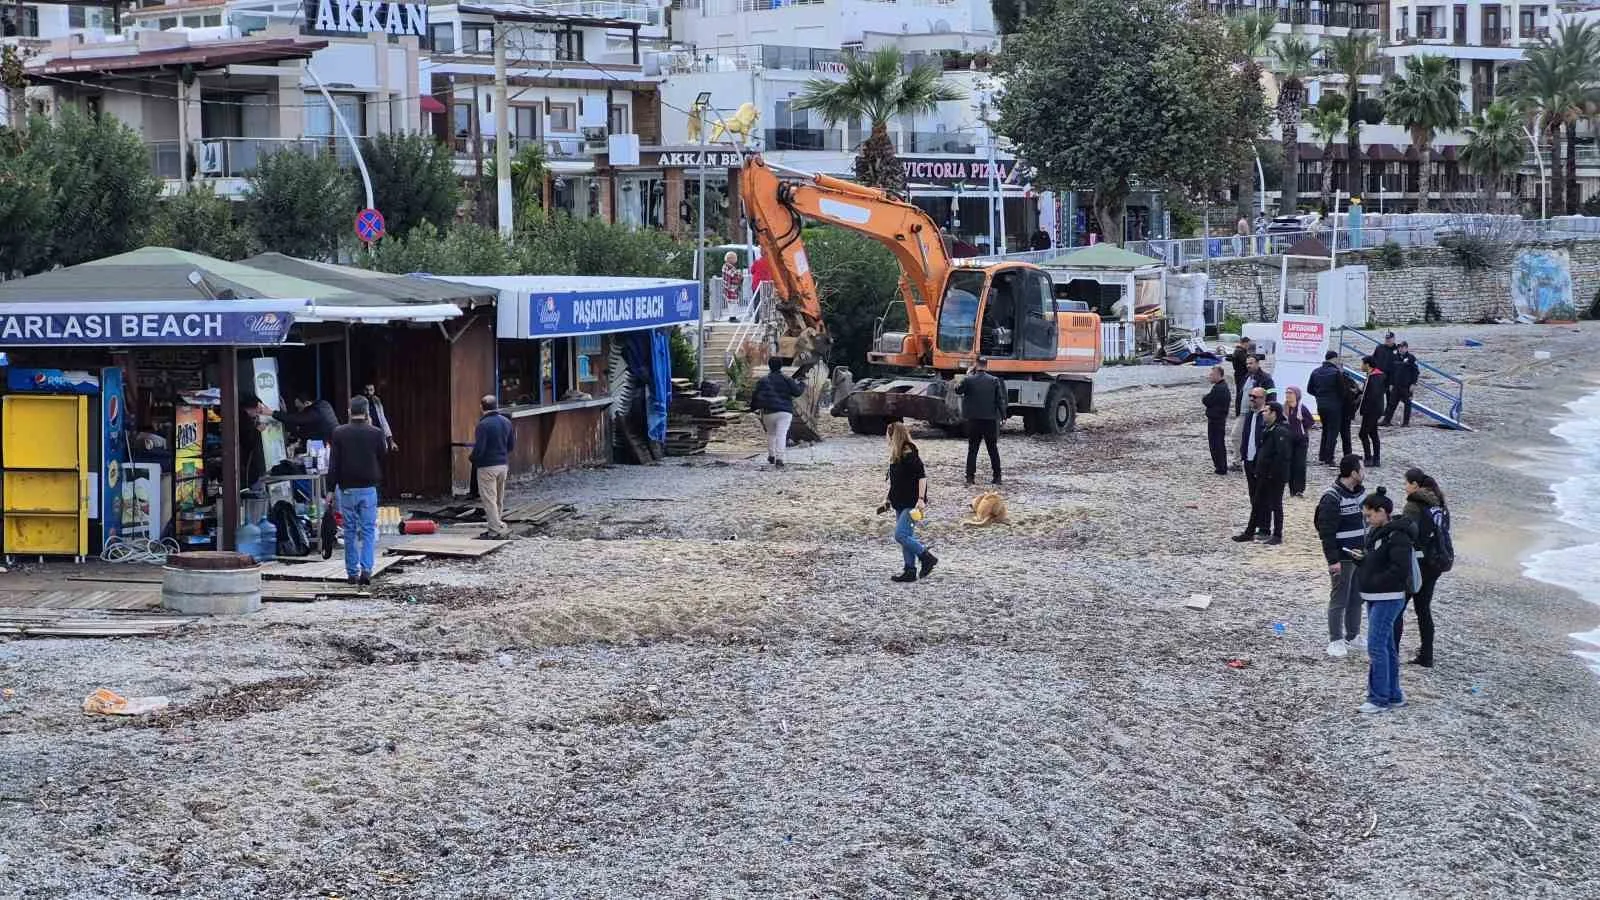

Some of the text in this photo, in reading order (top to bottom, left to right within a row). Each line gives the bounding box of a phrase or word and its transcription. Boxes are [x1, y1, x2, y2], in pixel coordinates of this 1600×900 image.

[315, 0, 427, 35] AKKAN
[658, 152, 717, 166] AKKAN
[903, 161, 967, 178] VICTORIA
[572, 296, 634, 329] PAŞATARLASI
[635, 295, 664, 320] BEACH
[0, 314, 223, 338] ARLASI BEACH
